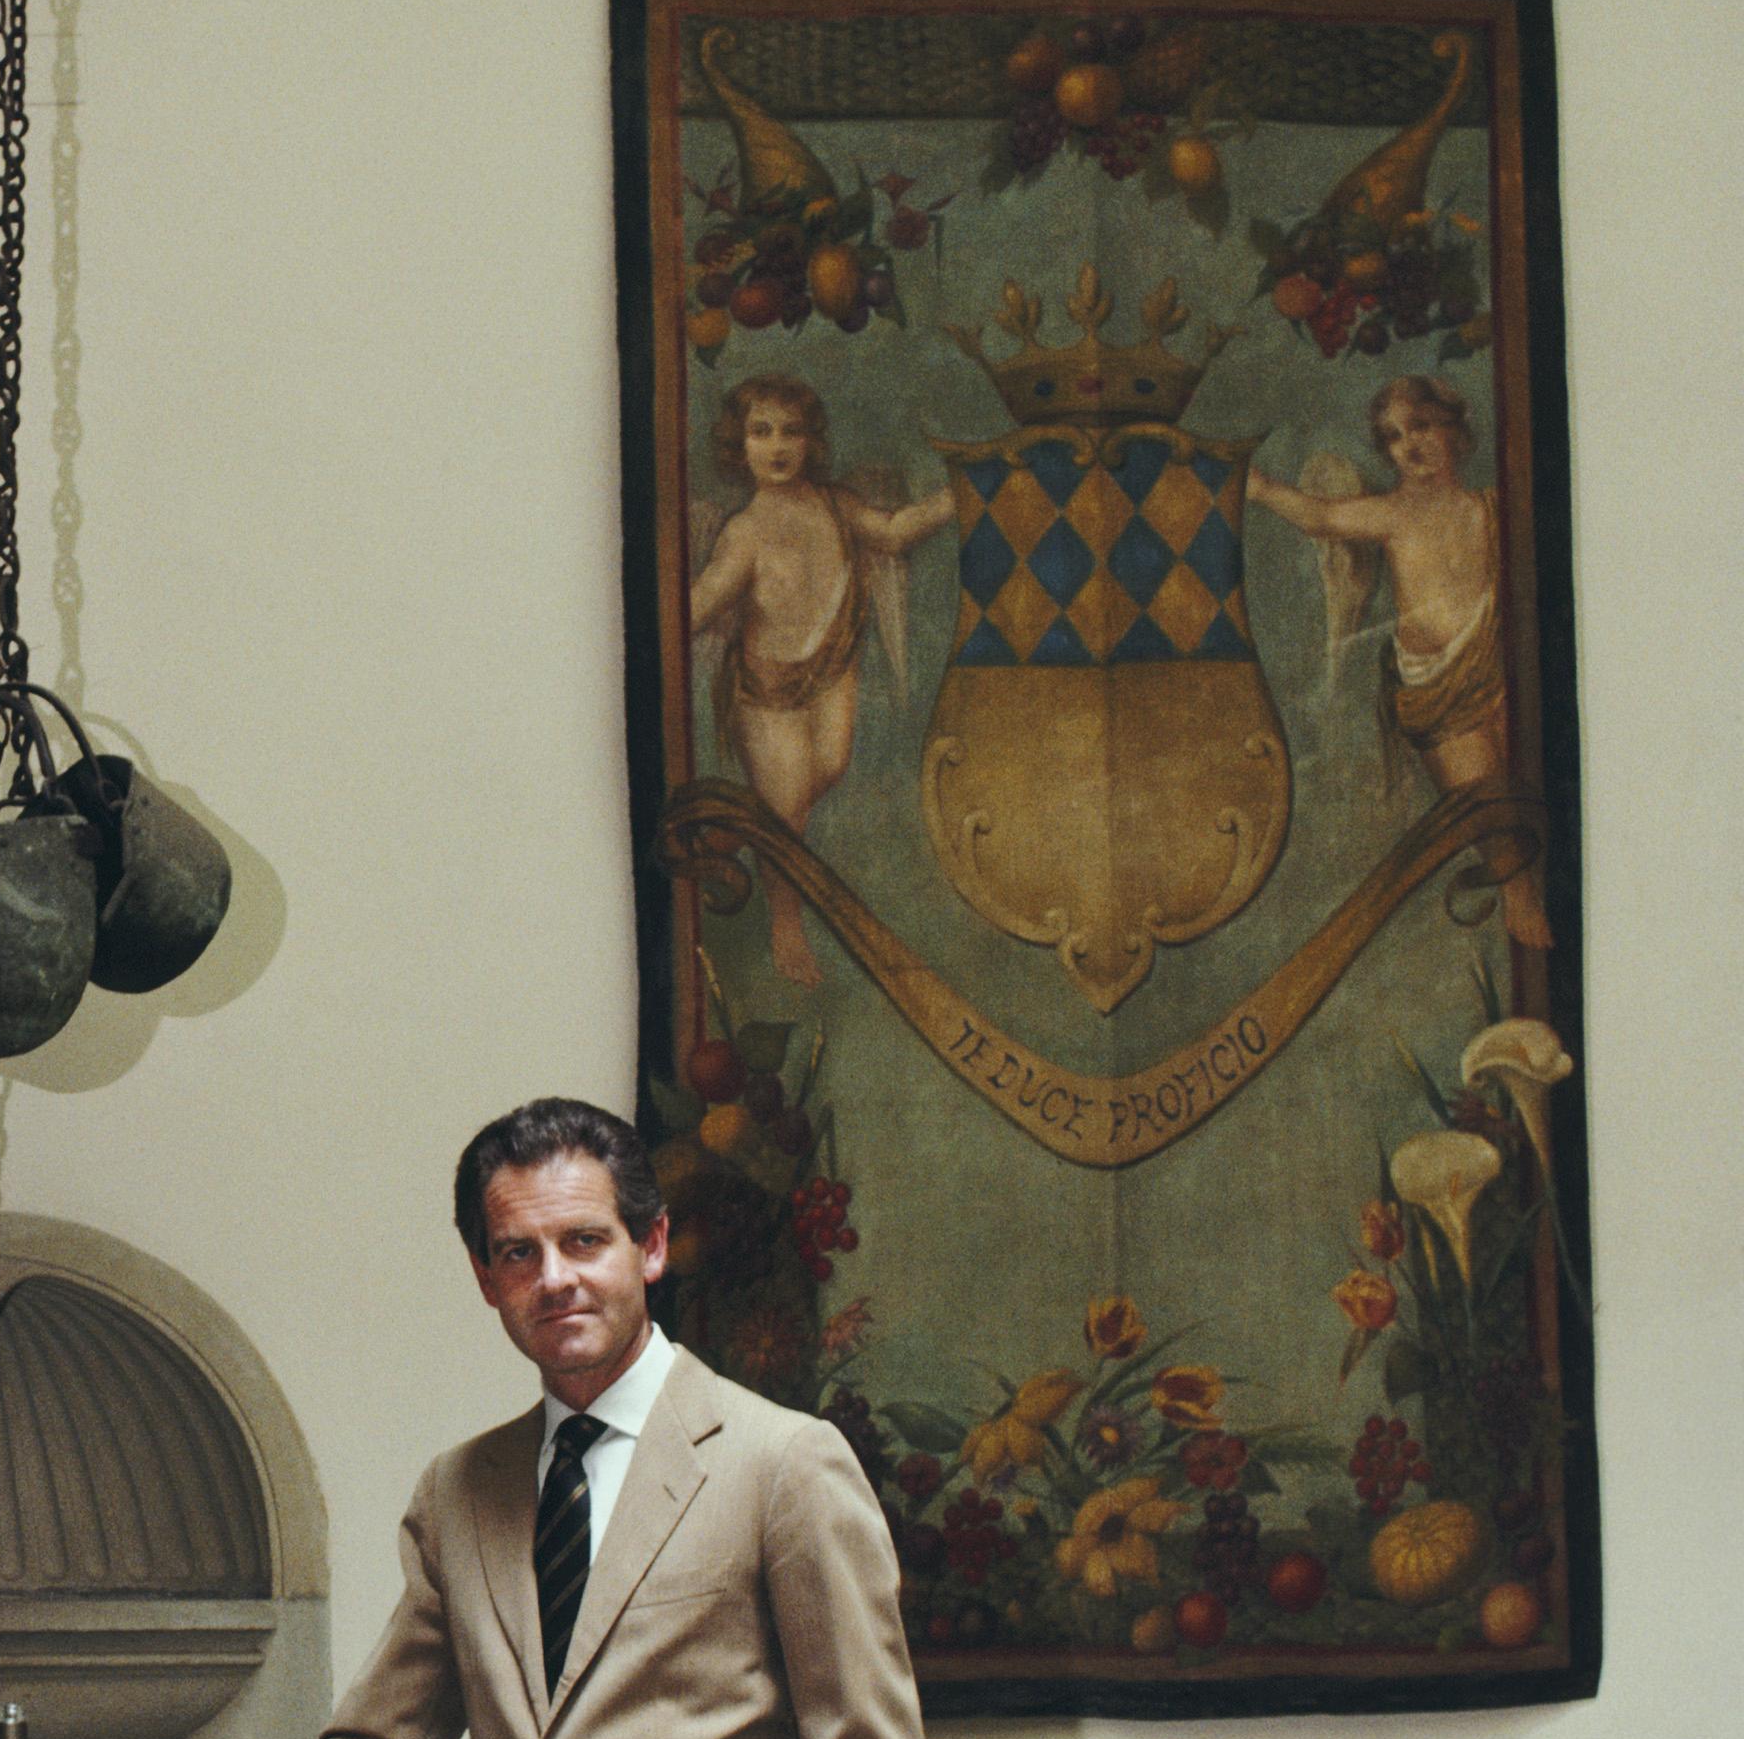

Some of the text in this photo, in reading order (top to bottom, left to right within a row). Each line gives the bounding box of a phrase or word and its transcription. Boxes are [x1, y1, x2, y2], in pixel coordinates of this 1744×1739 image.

[948, 1016, 1266, 1143] TE DUCE PROFICIO
